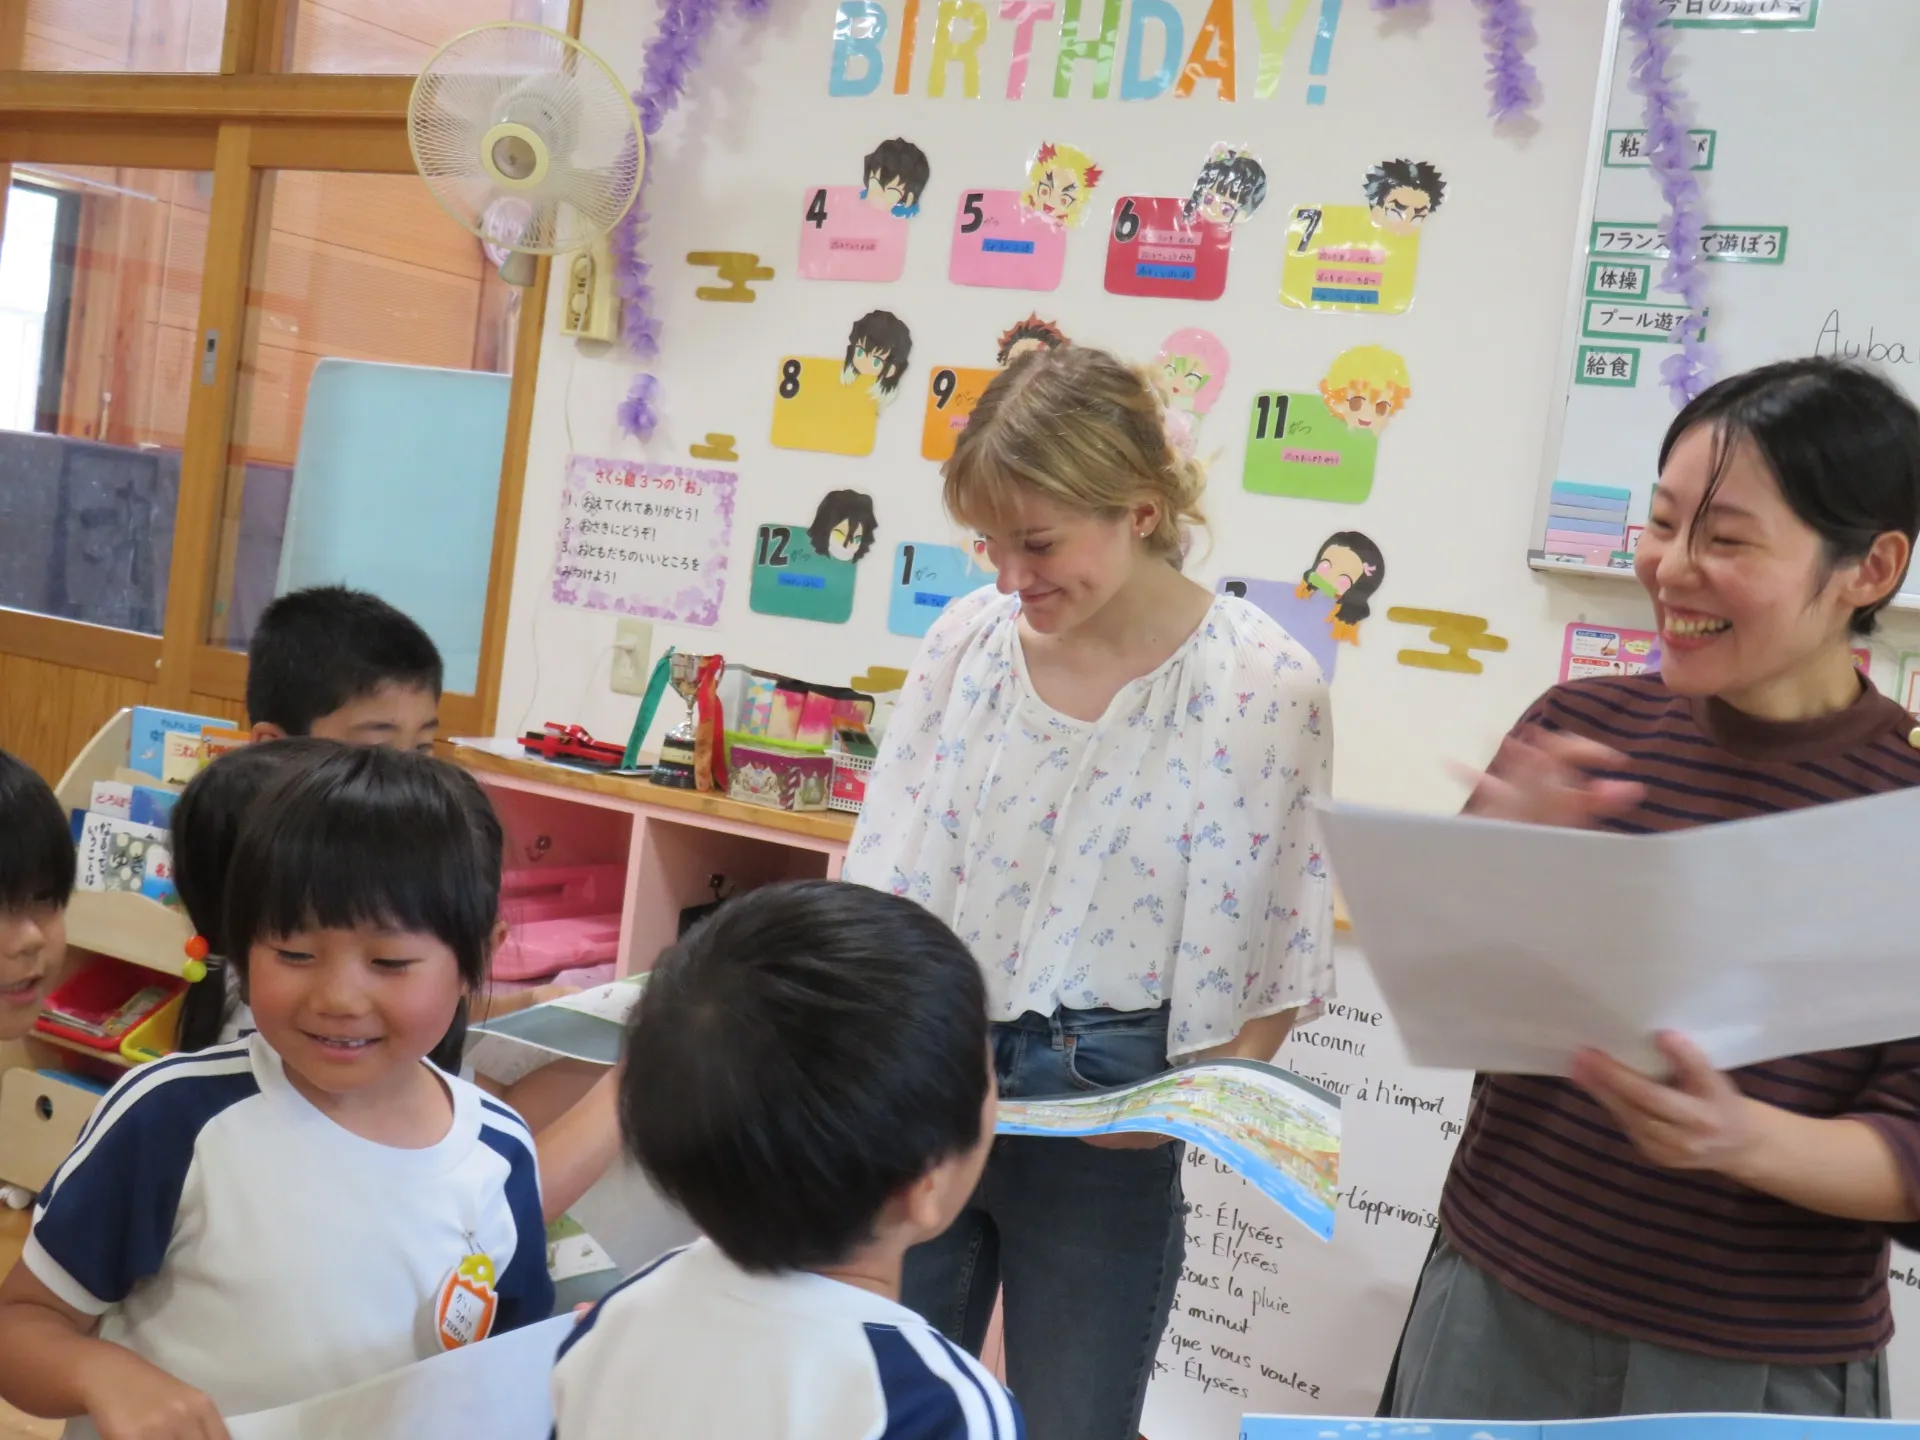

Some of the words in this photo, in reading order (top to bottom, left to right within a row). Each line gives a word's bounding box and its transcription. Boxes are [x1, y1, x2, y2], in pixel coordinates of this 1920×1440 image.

[828, 0, 1342, 105] BIRTHDAY!
[805, 188, 828, 229] 4
[960, 193, 984, 234] 5
[1114, 198, 1140, 243] 6
[1296, 208, 1322, 252] 7
[1599, 231, 1777, 256] フランスで遊ぼう
[1600, 270, 1637, 290] 体操
[779, 359, 802, 399] 8
[1585, 356, 1630, 378] 給食
[932, 369, 957, 411] 9
[1255, 395, 1290, 439] 11
[758, 526, 791, 566] 12
[901, 544, 915, 586] 1
[1327, 1001, 1384, 1028] venue
[1356, 1077, 1369, 1102] à
[1440, 1117, 1463, 1141] qui
[1187, 1146, 1208, 1168] de
[1227, 1275, 1244, 1298] la
[1252, 1286, 1292, 1317] pluie
[1187, 1306, 1251, 1335] minuit
[1210, 1343, 1252, 1369] vous
[1259, 1364, 1321, 1400] voulez
